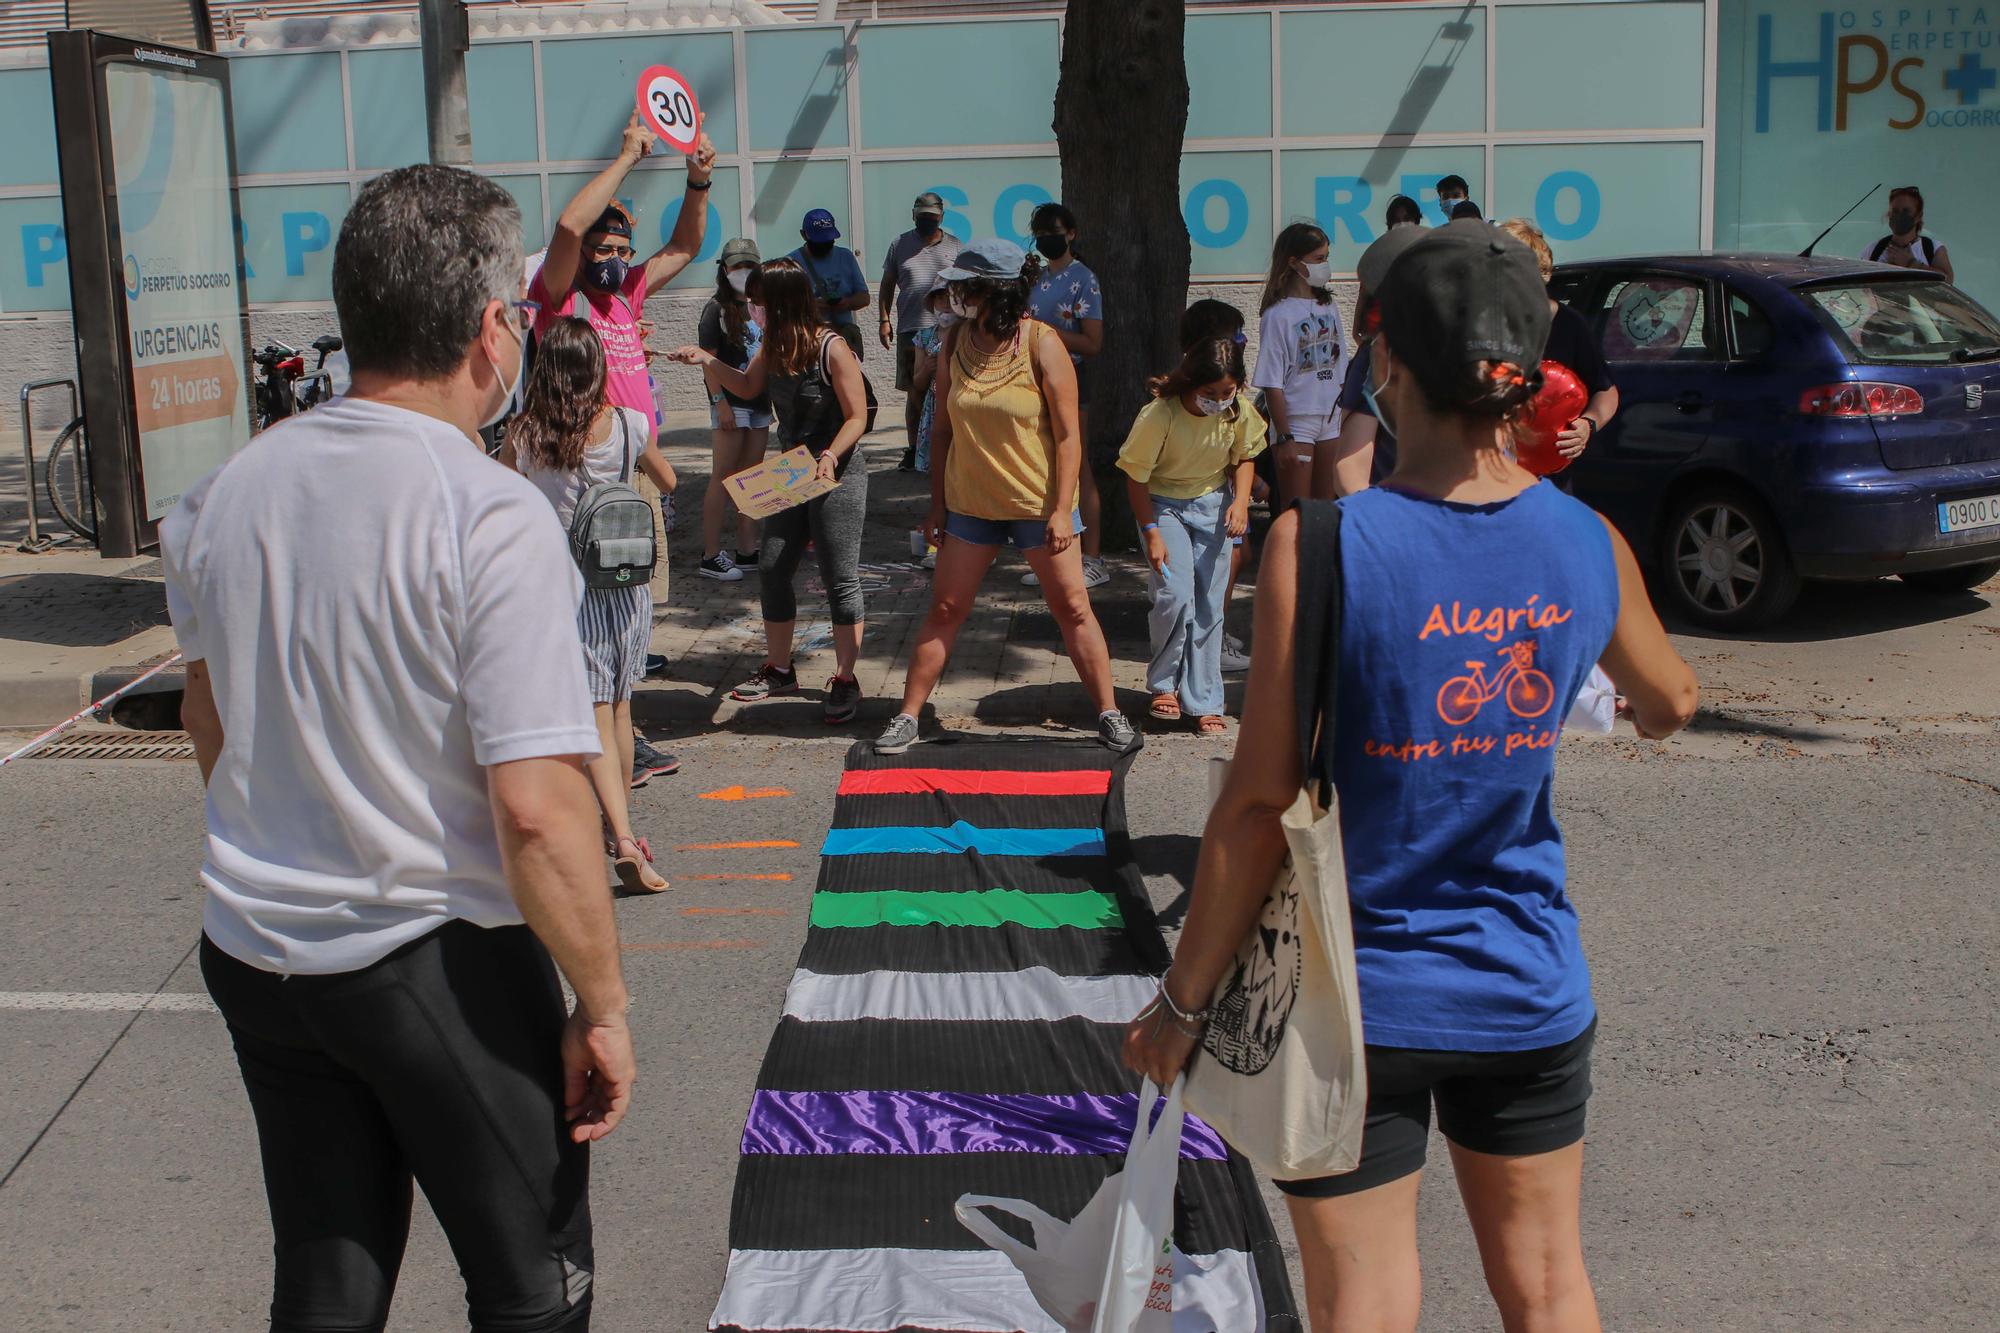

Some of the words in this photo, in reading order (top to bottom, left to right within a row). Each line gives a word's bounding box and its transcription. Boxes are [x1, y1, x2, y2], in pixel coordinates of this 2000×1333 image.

[1890, 31, 2000, 50] ERPETU
[652, 90, 693, 129] 30
[142, 274, 188, 293] PERPETUO
[190, 272, 231, 290] SOCORRO
[134, 322, 222, 359] URGENCIAS
[151, 376, 171, 410] 24
[173, 375, 222, 406] horas
[1949, 500, 1986, 526] 0900
[1417, 594, 1574, 642] Alegría
[1364, 736, 1446, 764] entre
[1449, 731, 1499, 757] tus
